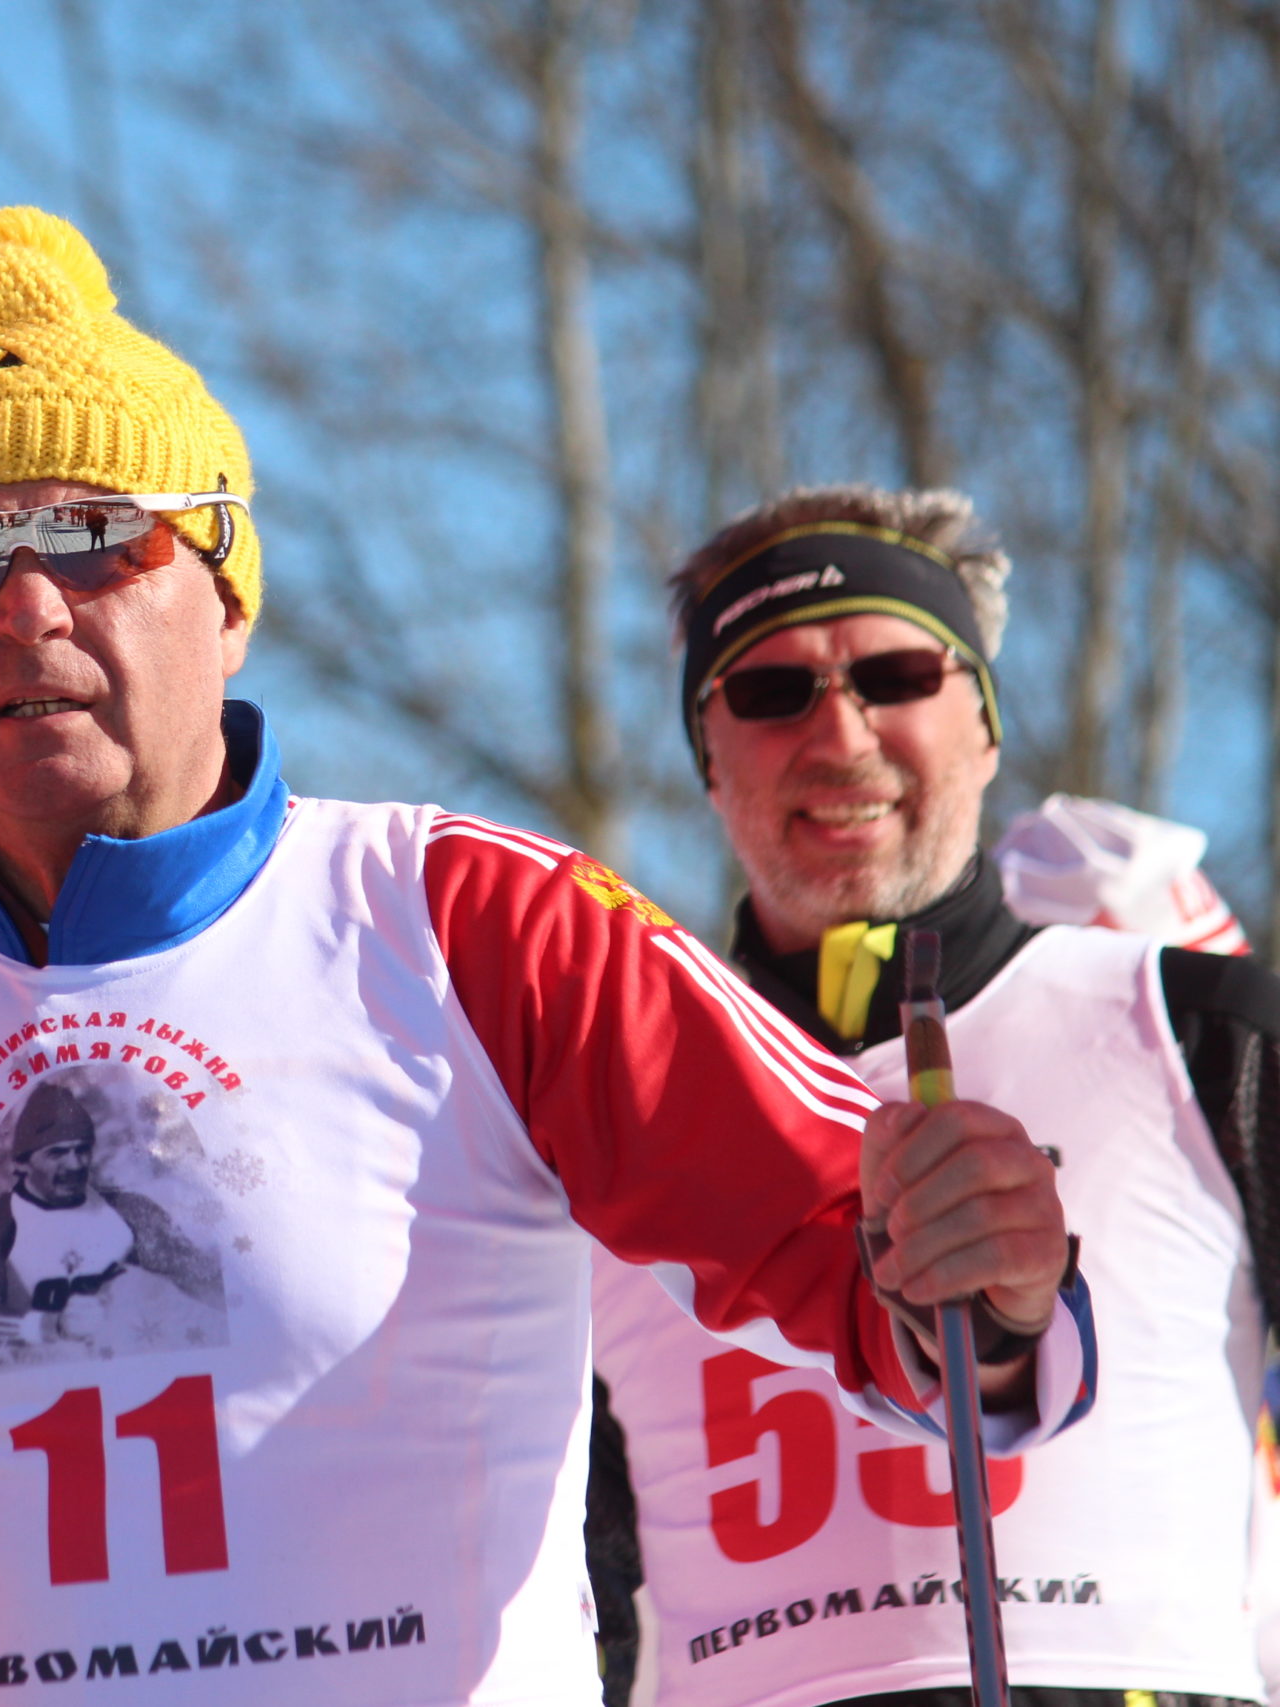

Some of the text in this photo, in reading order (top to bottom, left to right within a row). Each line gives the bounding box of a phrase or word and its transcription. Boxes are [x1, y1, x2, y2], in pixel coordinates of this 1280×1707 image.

[7, 1042, 206, 1110] ЗИМЯТОВА
[137, 1018, 242, 1092] ЛЫЖНЯ
[9, 1373, 229, 1586] 11
